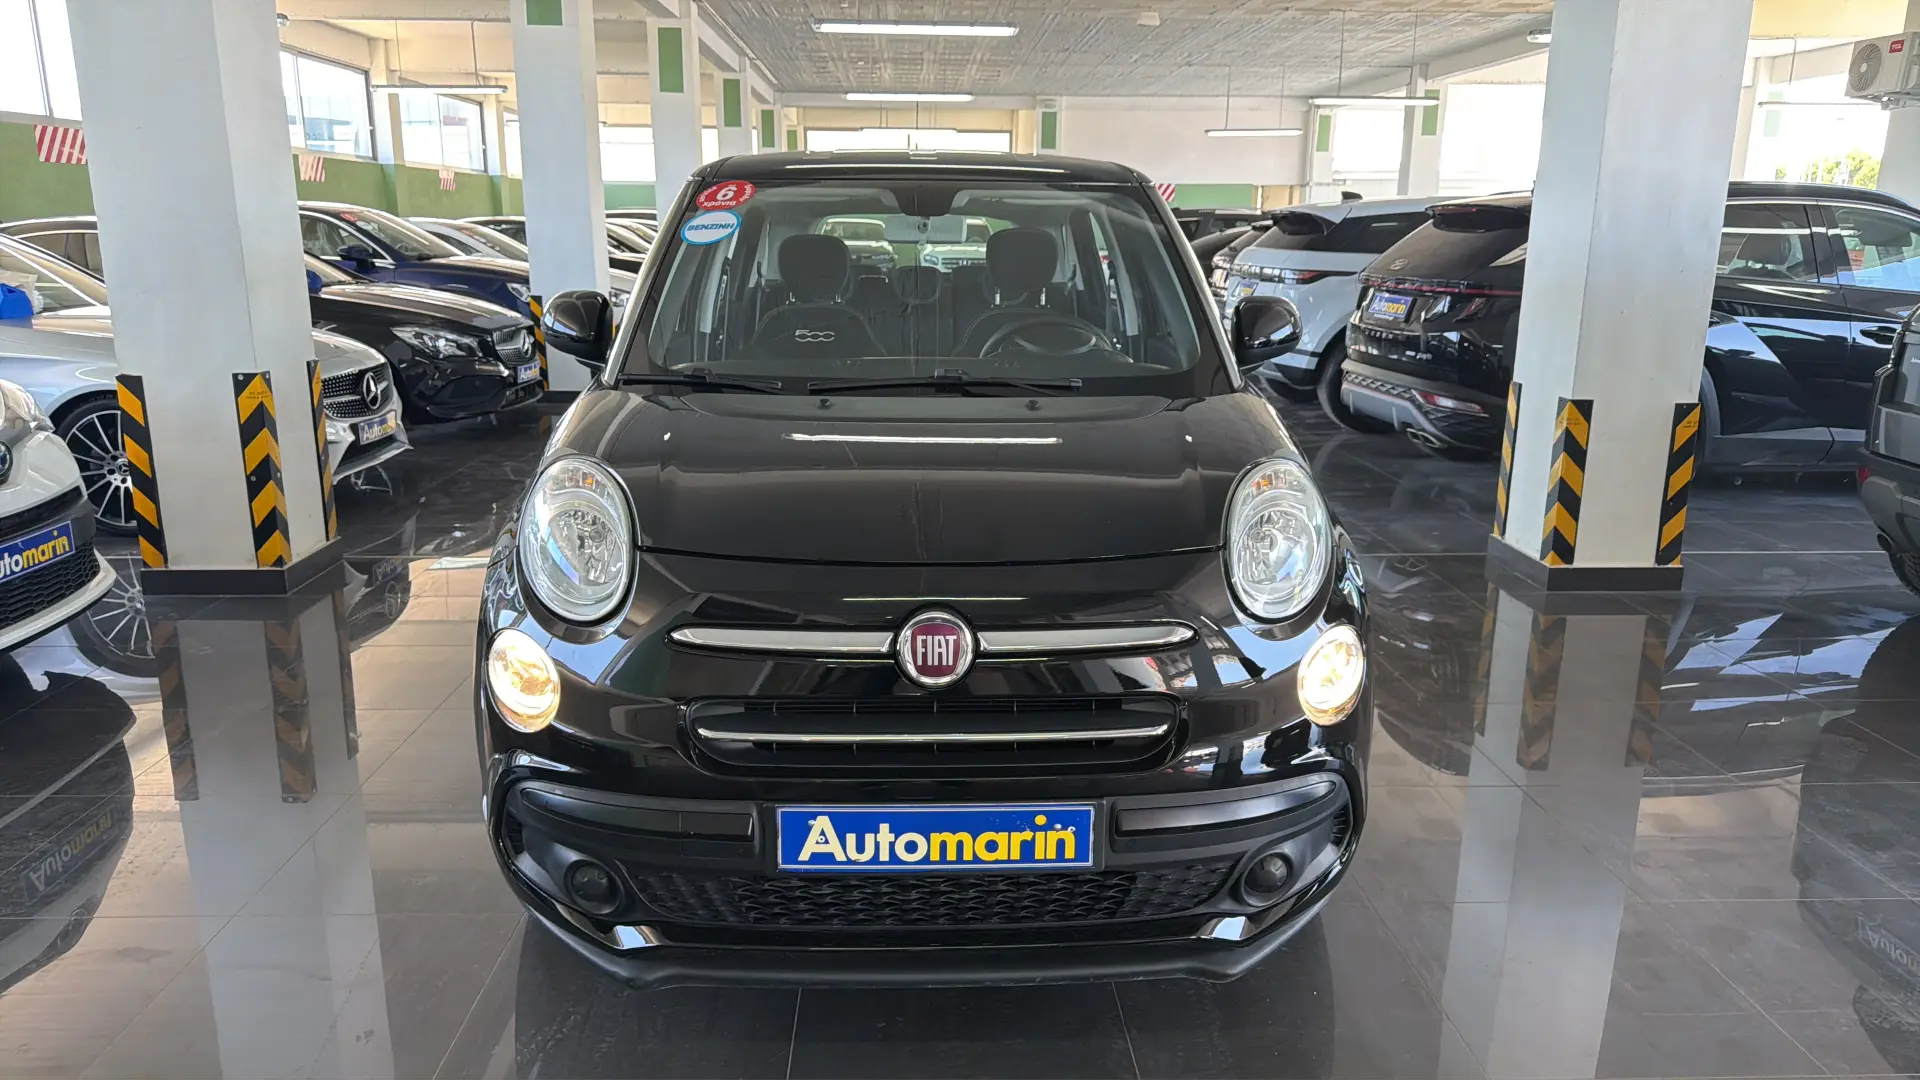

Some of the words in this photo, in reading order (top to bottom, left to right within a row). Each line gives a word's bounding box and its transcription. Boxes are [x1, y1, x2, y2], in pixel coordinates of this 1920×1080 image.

[716, 186, 737, 201] 6
[795, 329, 835, 342] 500
[916, 635, 957, 666] FIAT
[798, 814, 1076, 863] Automarin
